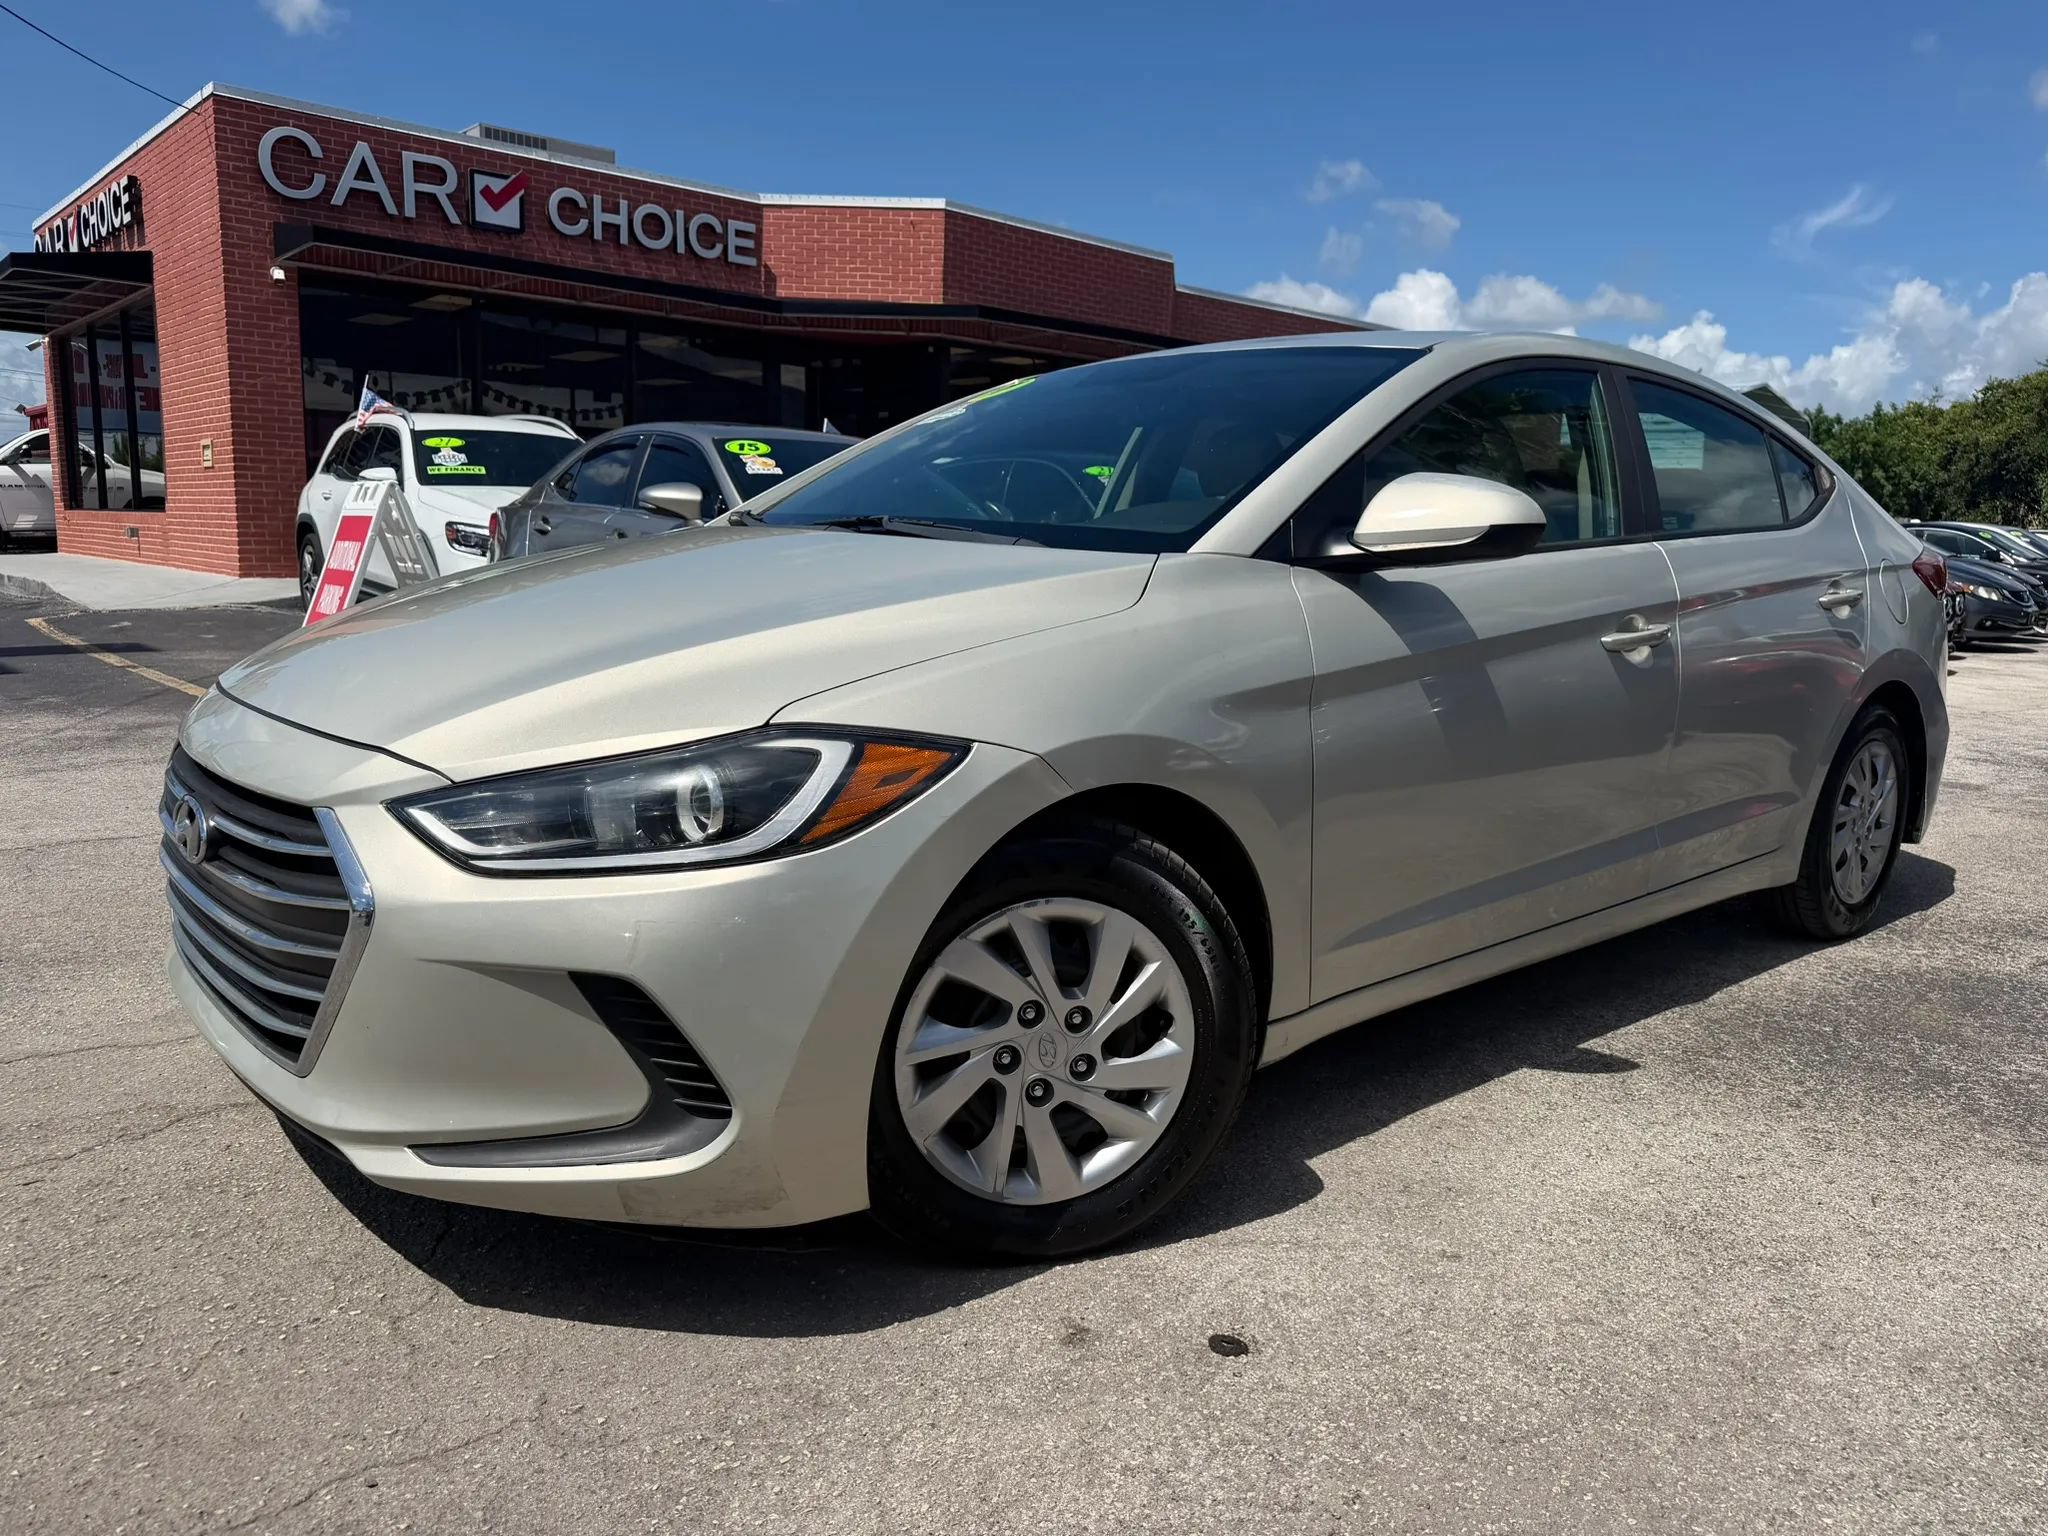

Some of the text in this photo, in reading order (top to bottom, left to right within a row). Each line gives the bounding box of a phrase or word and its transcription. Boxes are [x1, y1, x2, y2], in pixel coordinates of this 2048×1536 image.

[80, 175, 132, 248] CHOICE
[257, 126, 758, 267] CAR CHOICE
[738, 442, 760, 452] 15
